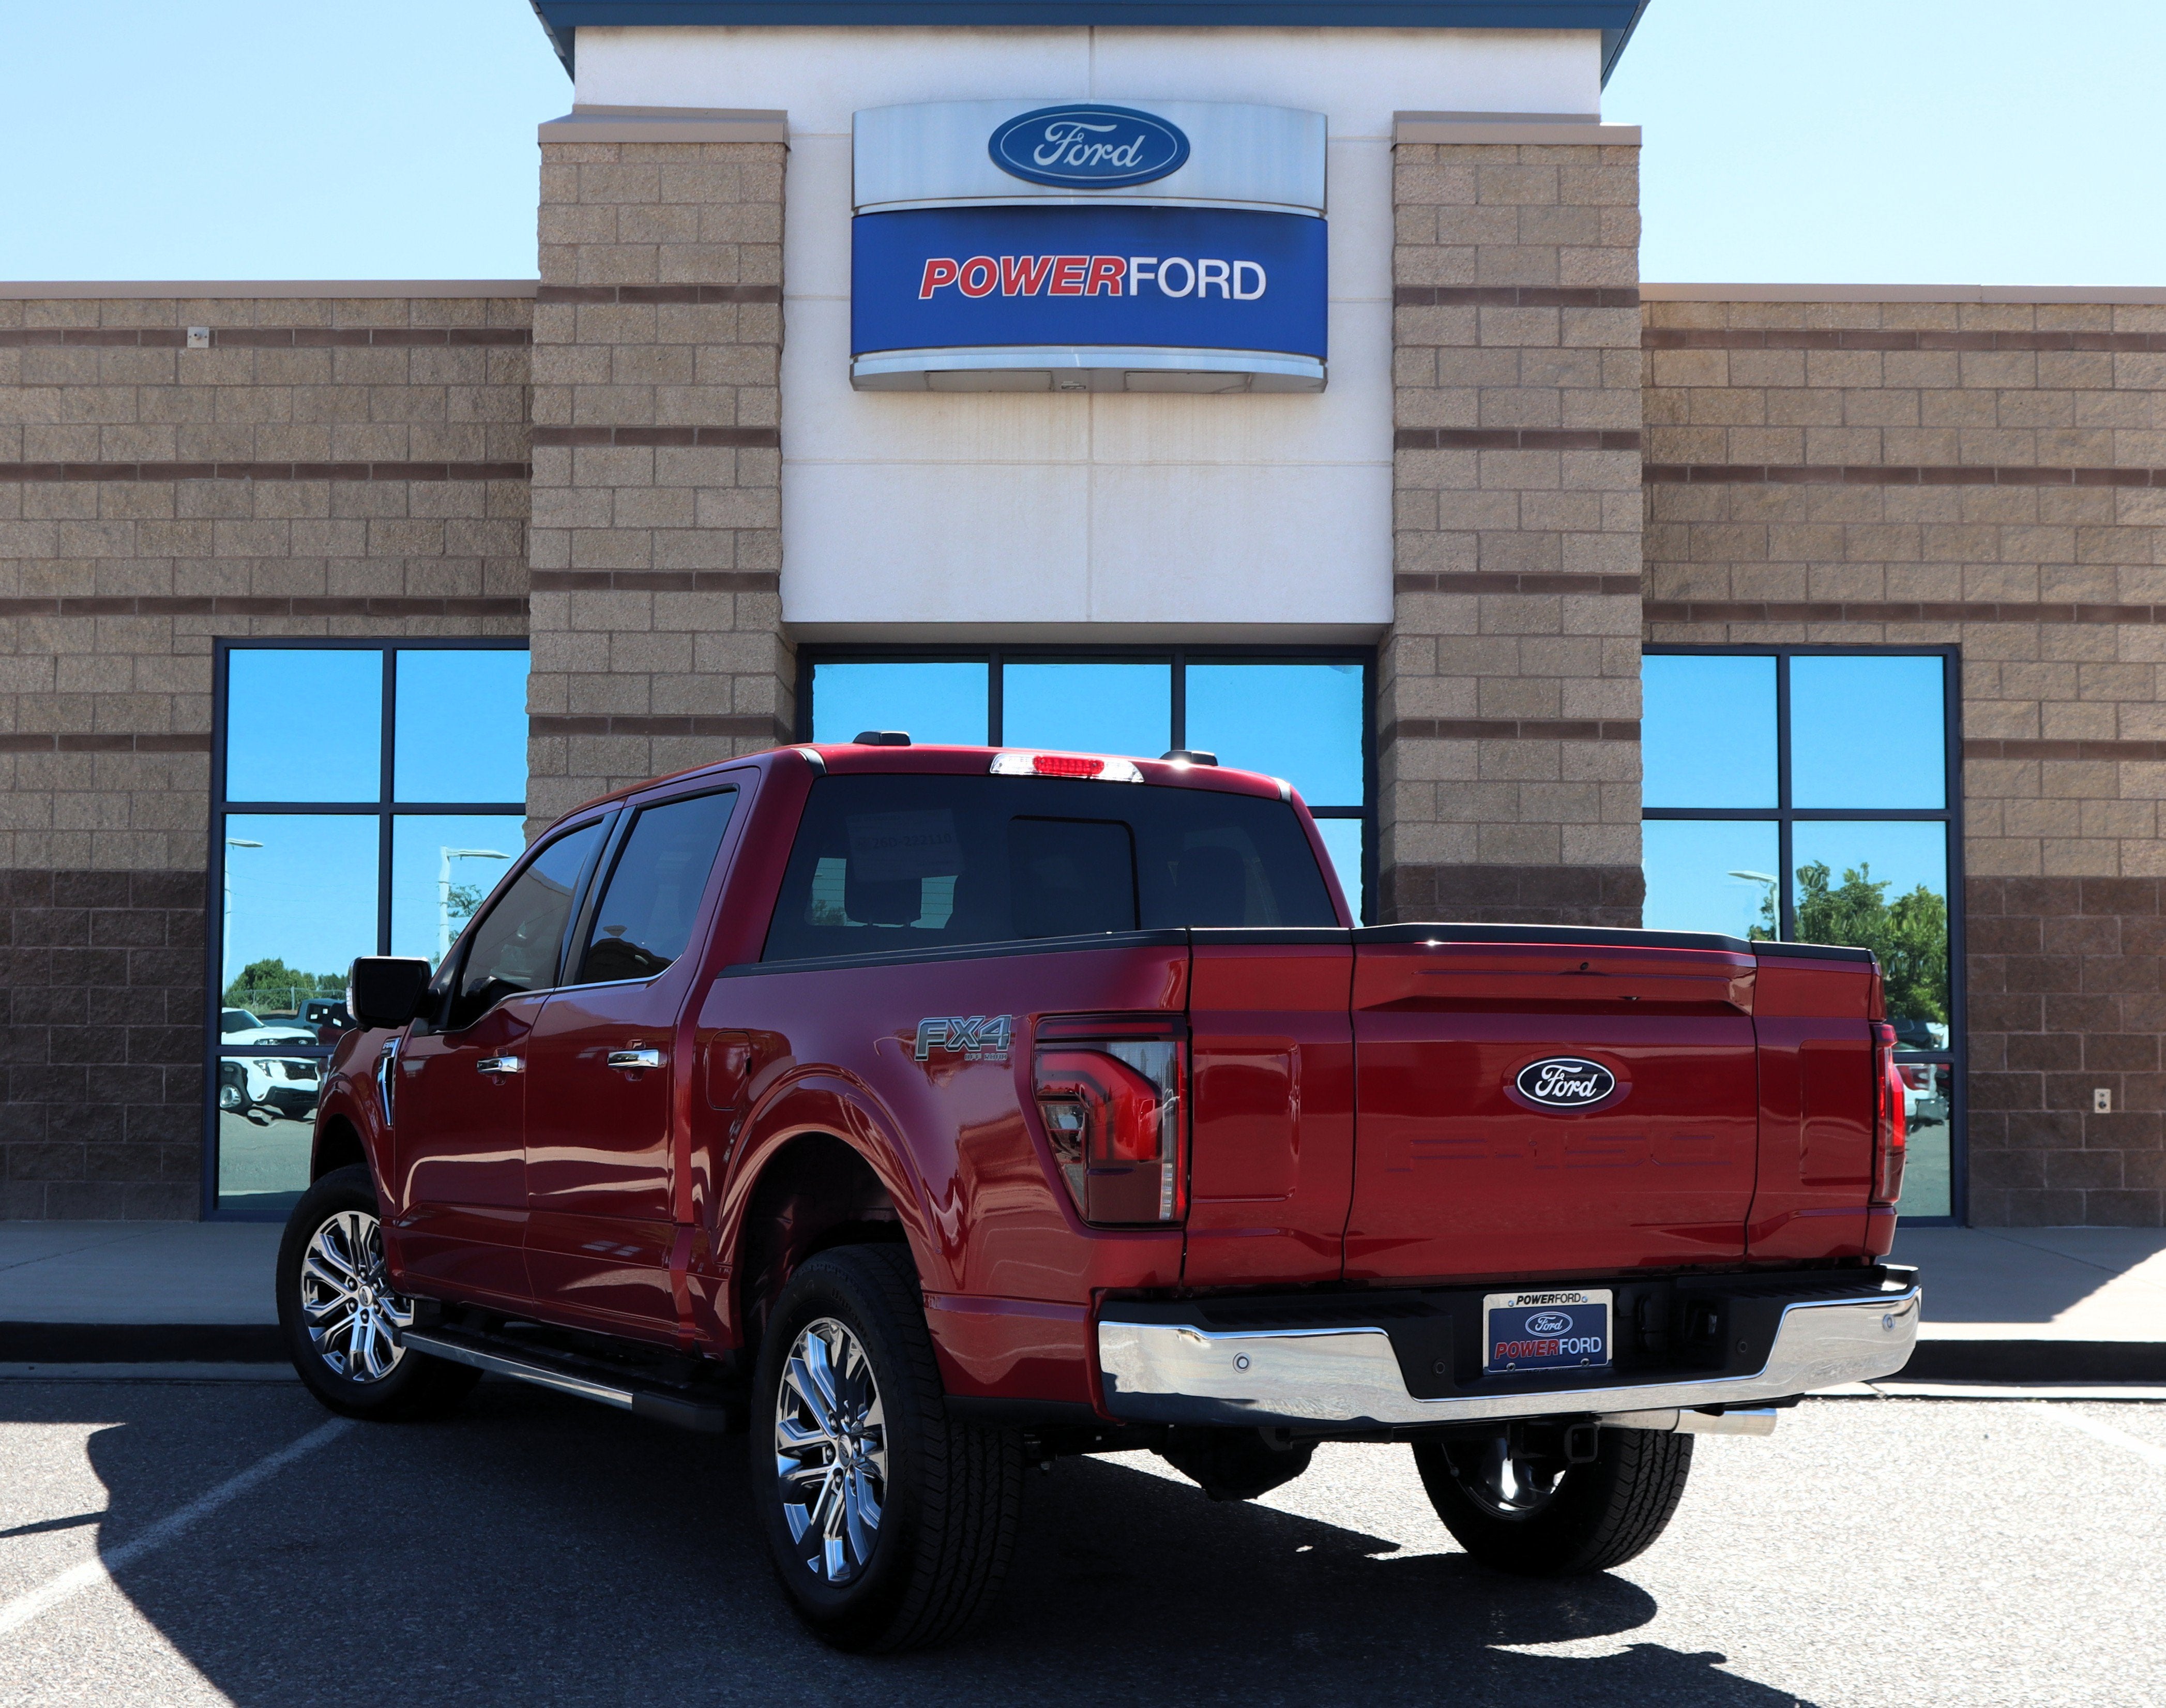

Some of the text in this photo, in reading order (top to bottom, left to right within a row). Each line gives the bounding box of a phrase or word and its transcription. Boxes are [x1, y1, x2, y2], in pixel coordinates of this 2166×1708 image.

[1034, 121, 1145, 167] Ford
[914, 1015, 1012, 1062] FX4
[1534, 1064, 1598, 1098] Ford
[1535, 1317, 1563, 1331] Ford
